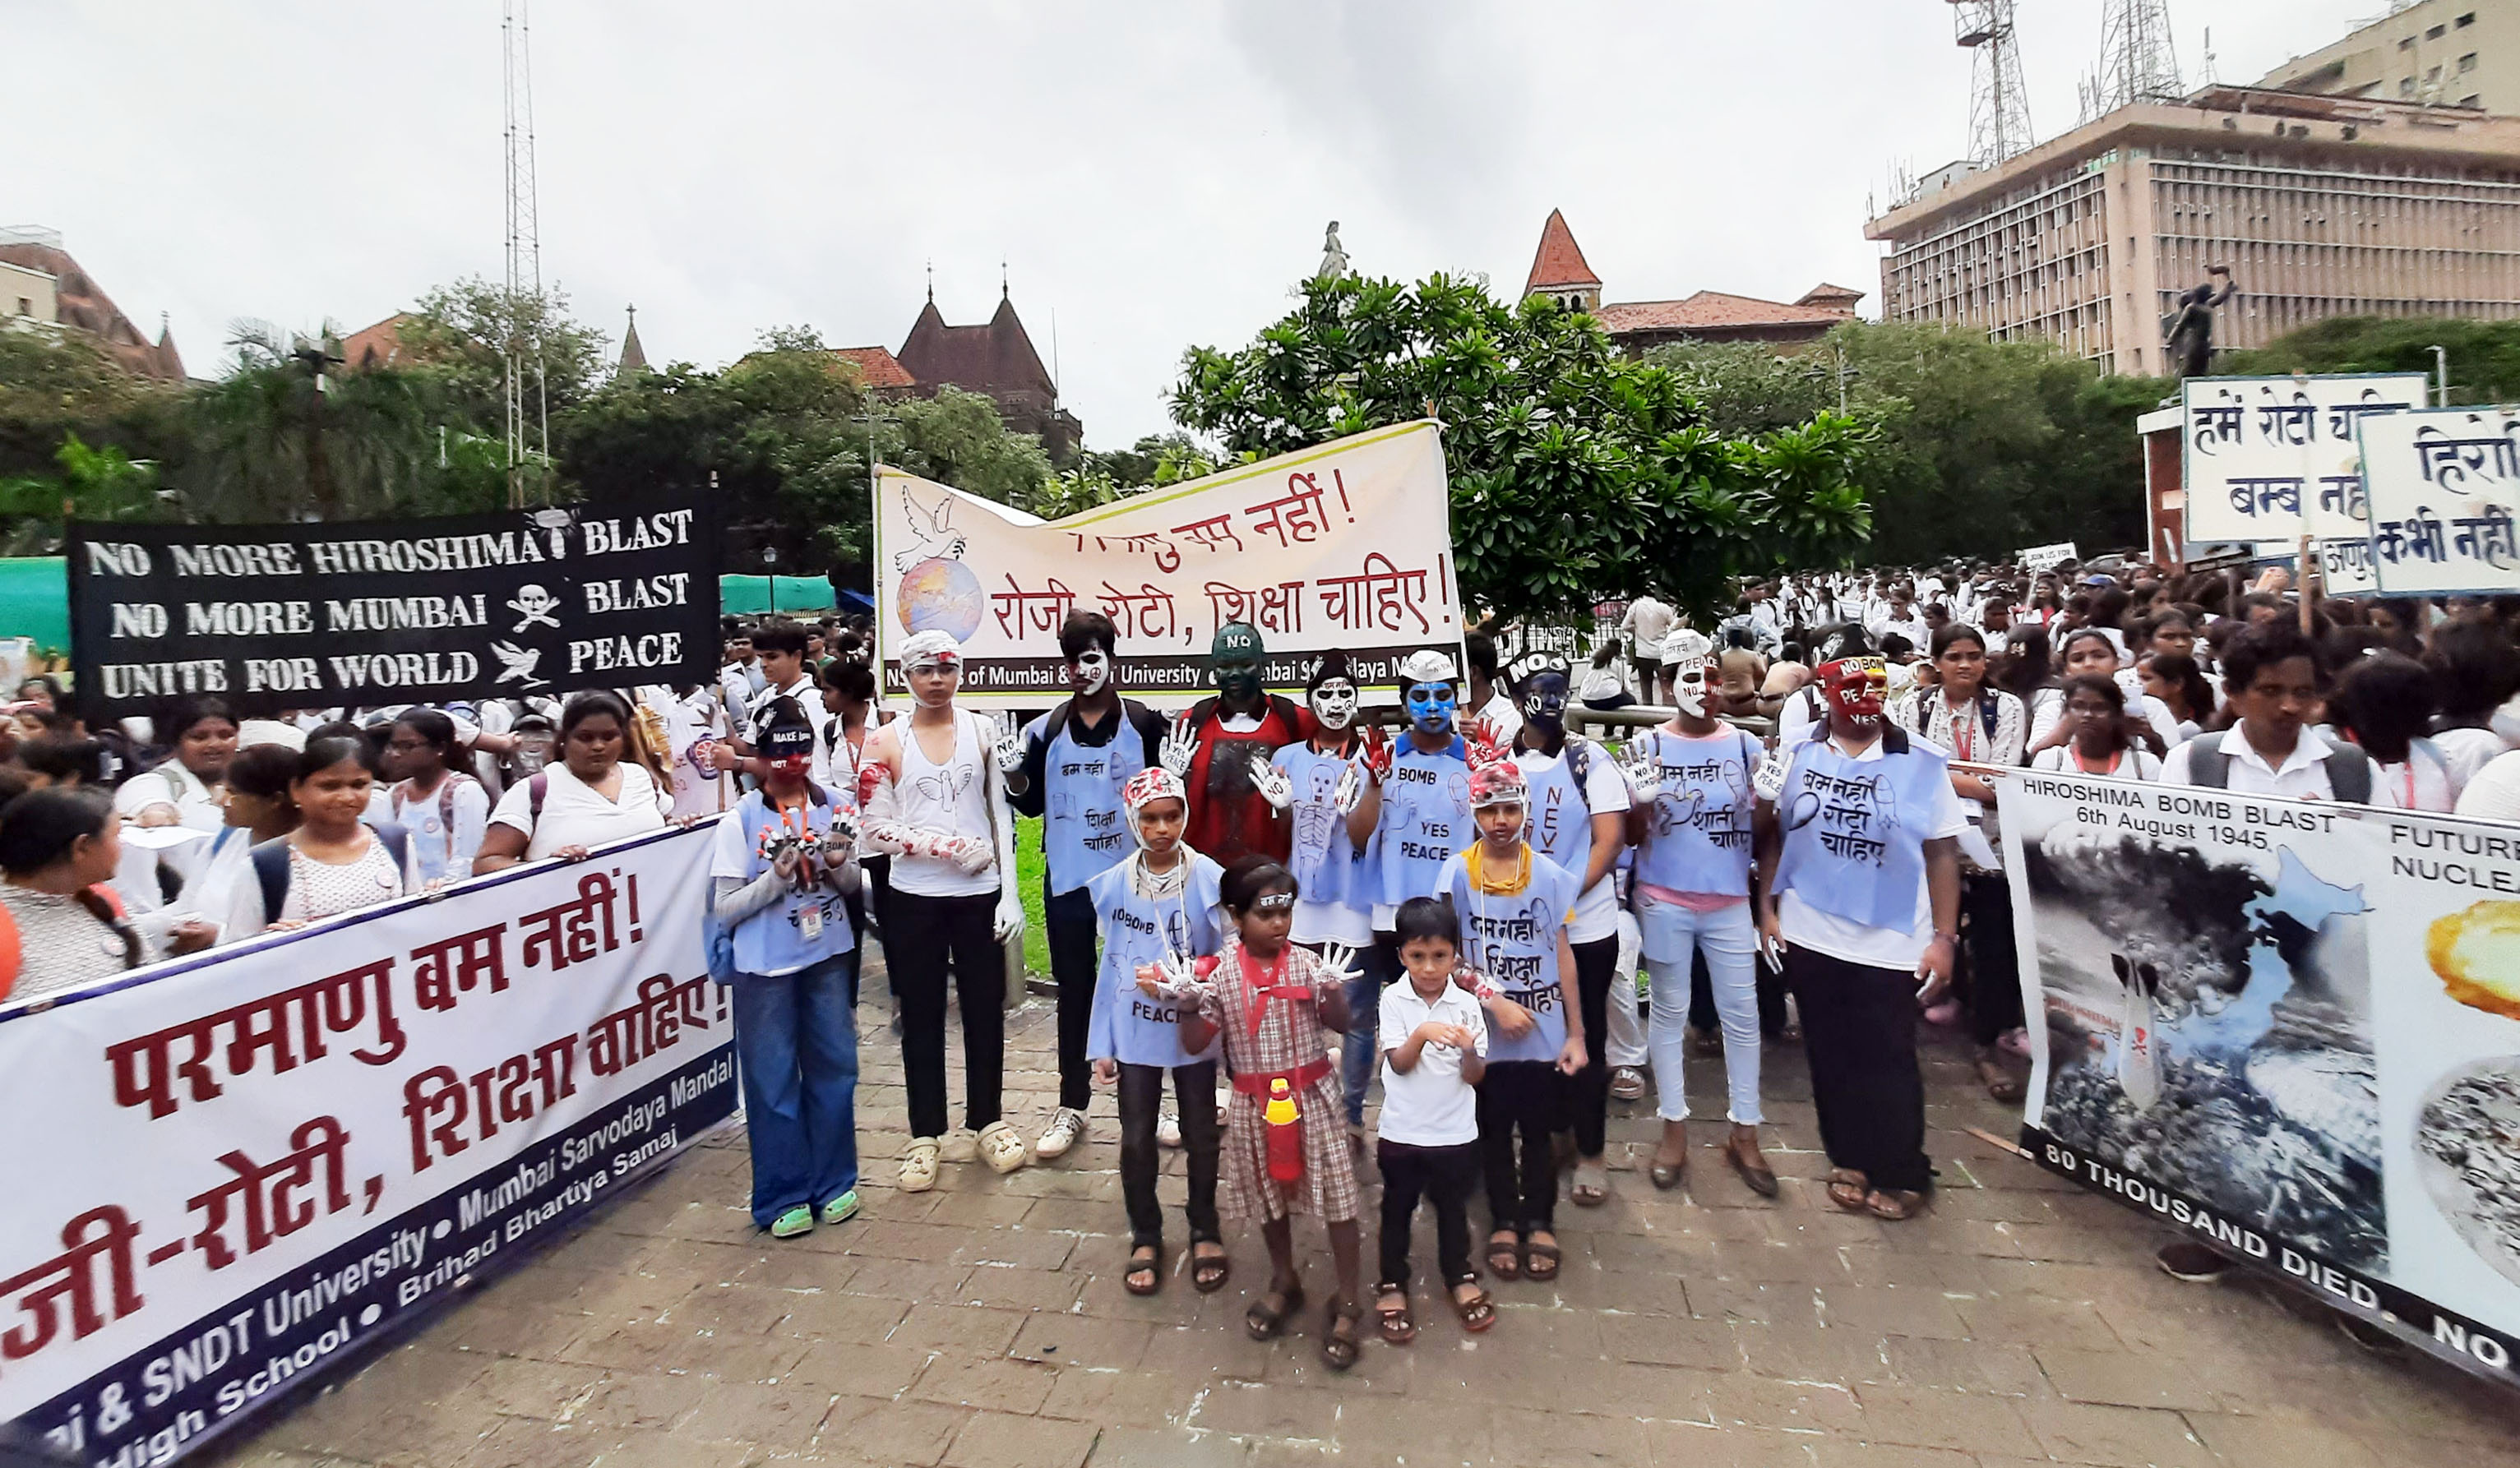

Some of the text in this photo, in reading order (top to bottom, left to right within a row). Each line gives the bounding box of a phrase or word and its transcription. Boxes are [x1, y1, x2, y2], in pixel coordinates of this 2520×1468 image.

[2192, 389, 2245, 455] हमें
[2257, 386, 2318, 447] रोटी
[86, 509, 692, 576] NO MORE HIROSHIMA BLAST
[2377, 505, 2448, 564] कभी
[2029, 549, 2070, 561] JOIN US FOR
[110, 573, 690, 638] NO MORE MUMBAI BLAST
[1227, 635, 1251, 649] NO
[100, 632, 682, 699] UNITE FOR WORLD PEACE
[1509, 653, 1548, 683] NO
[1685, 657, 1718, 670] PEACE
[1840, 658, 1885, 676] NO BOM
[969, 665, 986, 686] of
[992, 664, 1053, 686] Mumbai
[1057, 666, 1070, 685] &
[1121, 662, 1200, 688] University
[1683, 686, 1698, 697] NO
[1524, 695, 1542, 718] NO
[1850, 713, 1879, 725] YES
[773, 731, 797, 743] MAKE
[997, 739, 1015, 754] NO
[997, 749, 1025, 769] BOMB
[1172, 745, 1186, 759] YES
[1164, 754, 1186, 772] PEACE
[1766, 763, 1782, 777] YES
[1399, 768, 1437, 785] BOMB
[1758, 773, 1783, 793] PEACE
[1267, 782, 1283, 798] NO
[2023, 778, 2336, 833] HIROSHIMA BOMB BLAST
[1421, 821, 1450, 838] YES
[2076, 806, 2107, 827] 6th
[2117, 815, 2196, 840] August
[825, 841, 853, 853] BOMB
[1401, 841, 1450, 861] PEACE
[1820, 830, 1886, 868] चाहिए
[2393, 856, 2520, 893] NUCLE
[105, 957, 407, 1120] परमाणु
[410, 922, 510, 1013] बम
[403, 1032, 578, 1174] शिक्षा
[96, 1381, 133, 1435] &
[142, 1308, 255, 1408] SNDT
[262, 1226, 428, 1337] University
[459, 1148, 555, 1232] Mumbai
[561, 1094, 666, 1172] Sarvodaya
[671, 1051, 733, 1110] Mandal
[2045, 1143, 2078, 1171] 80
[2085, 1159, 2269, 1259] THOUSAND
[2434, 1314, 2508, 1369] NO
[215, 1314, 351, 1418] School
[398, 1230, 497, 1309] Brihad
[505, 1168, 608, 1244] Bhartiya
[613, 1124, 678, 1176] Samaj
